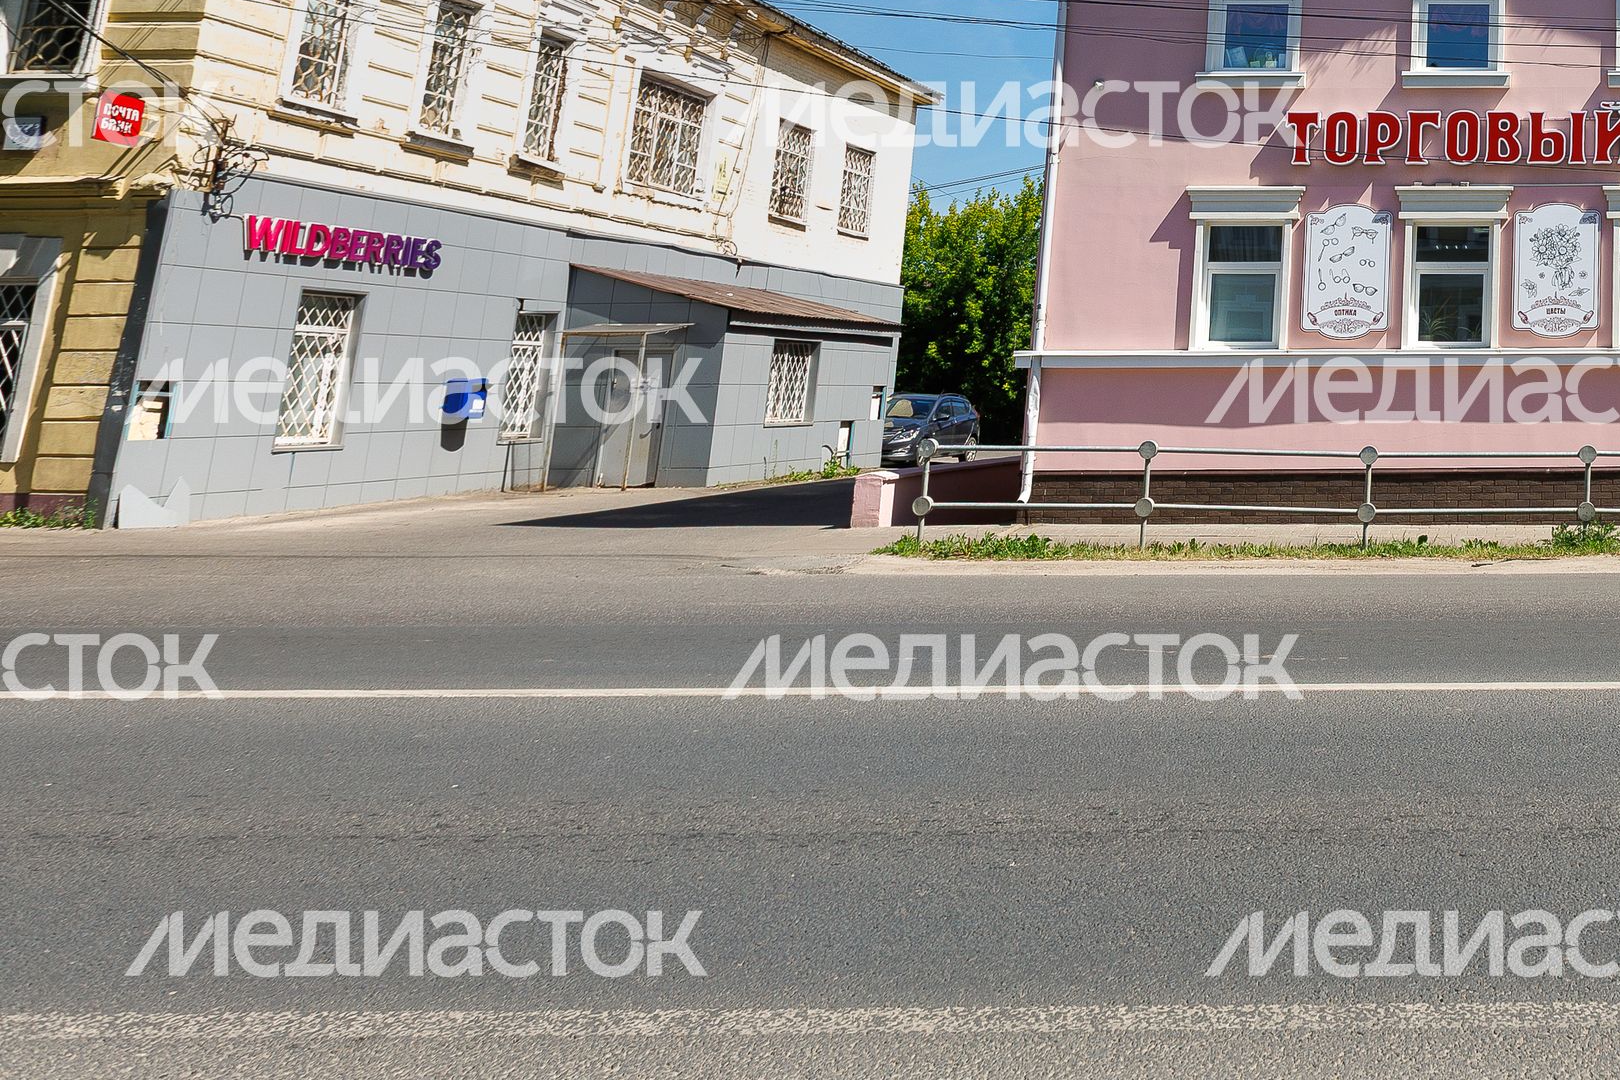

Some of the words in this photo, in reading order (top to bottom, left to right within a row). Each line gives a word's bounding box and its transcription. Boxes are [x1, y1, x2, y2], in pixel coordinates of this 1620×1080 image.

[103, 103, 140, 122] ПОЧТА
[244, 213, 443, 271] WILDBERRIES
[1334, 308, 1357, 317] ОПТИКА
[1546, 307, 1566, 315] ЦВЕТЫ
